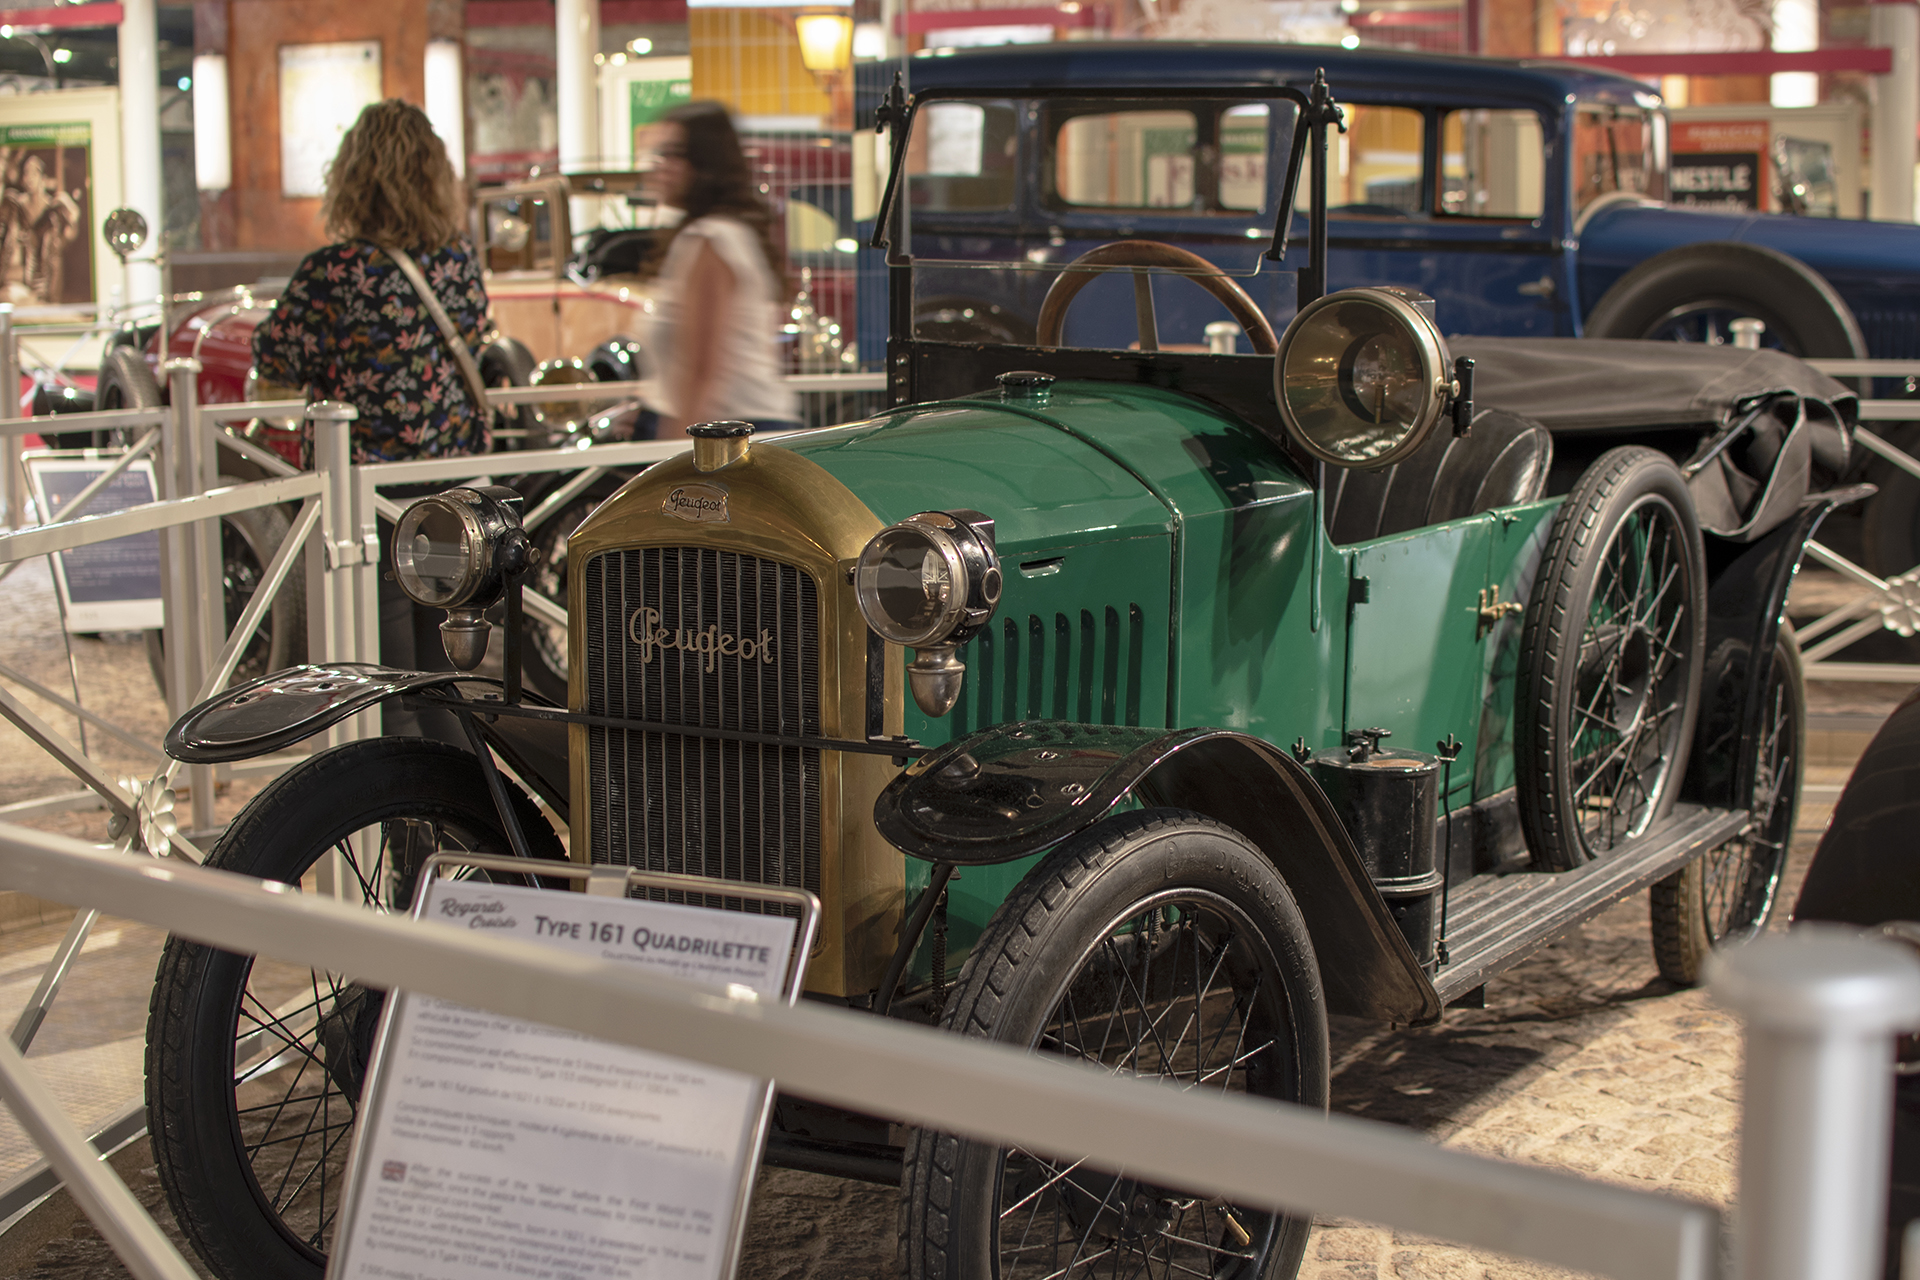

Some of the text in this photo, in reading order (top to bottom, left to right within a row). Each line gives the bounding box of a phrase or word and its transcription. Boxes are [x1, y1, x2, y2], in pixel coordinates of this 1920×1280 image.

[670, 489, 721, 518] Peugeot
[629, 607, 773, 673] Peugeot
[440, 898, 506, 917] Regards
[535, 915, 771, 963] TYPE 161 QUADRILETTE
